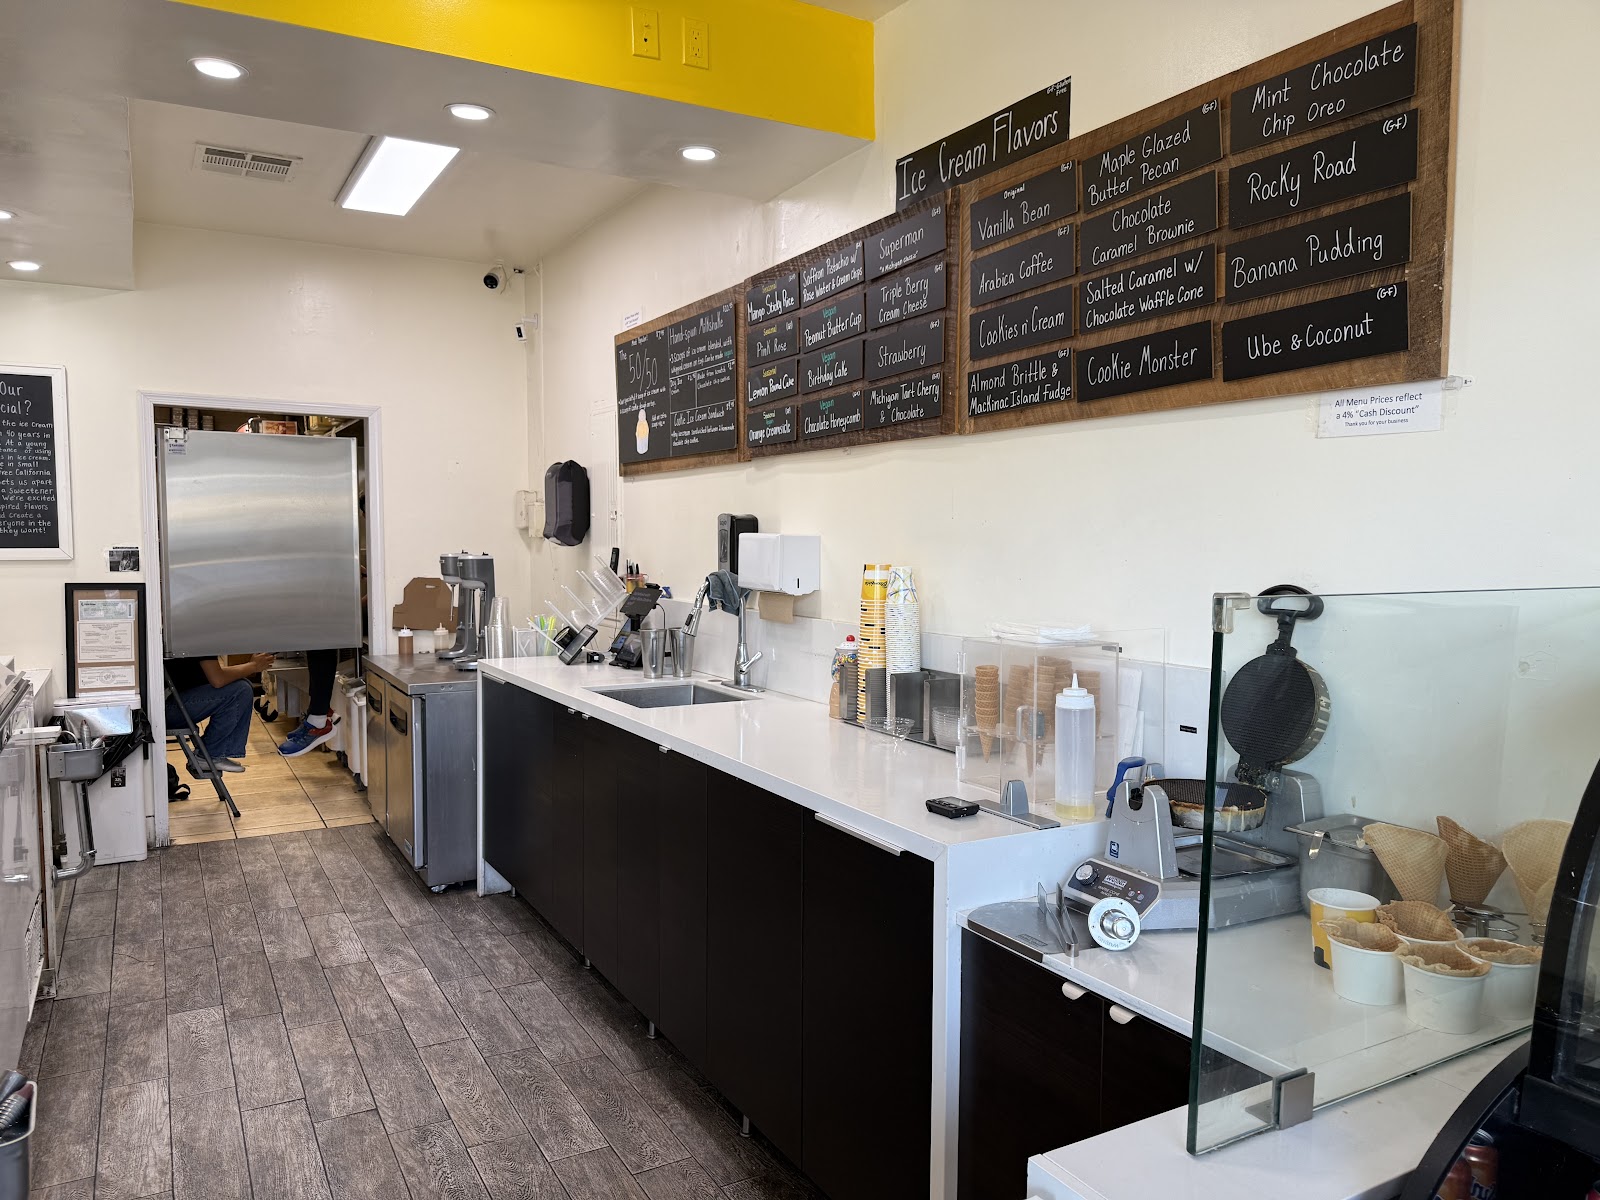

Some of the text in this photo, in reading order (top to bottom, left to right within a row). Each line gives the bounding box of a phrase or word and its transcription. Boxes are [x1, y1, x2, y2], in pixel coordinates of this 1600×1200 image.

[1252, 40, 1405, 113] Mint Chocolate
[1262, 98, 1346, 138] Chip Oreo
[898, 110, 1059, 201] Ice Cream Flavors
[1100, 120, 1191, 177] Maple Glazed
[1312, 141, 1357, 184] Road
[1003, 183, 1025, 199] Original
[1088, 157, 1179, 206] Butter Pecan
[978, 200, 1050, 241] Vanilla Bean
[1112, 195, 1171, 232] Chocolate
[879, 228, 924, 259] Superman
[1092, 219, 1194, 266] Caramel Brownie
[802, 267, 824, 287] Saffron
[826, 253, 849, 275] Pistachio
[1230, 226, 1384, 289] Banana Pudding
[978, 251, 1054, 295] Arabica Coffee
[1086, 251, 1204, 304] Salted Caramel w/
[880, 276, 929, 305] Triple Berry
[747, 301, 765, 322] Mango
[782, 289, 795, 308] Rice
[822, 305, 837, 320] Vegan
[878, 299, 928, 323] Cream Cheese
[1031, 305, 1065, 332] Cream
[1085, 285, 1204, 329] Chocolate Waffle Cone
[804, 312, 862, 347] Peanut Butter Cup
[1247, 311, 1374, 360] Ube & Coconut
[773, 337, 787, 353] Rose
[821, 351, 836, 367] Vegan
[877, 339, 926, 368] Strawberry
[1139, 340, 1198, 376] Monster
[629, 348, 658, 391] 50/50
[807, 364, 834, 388] Birthday
[969, 360, 1058, 393] Almond Brittle &
[0, 380, 23, 396] Our
[748, 381, 769, 402] Lemon
[769, 378, 782, 393] Pound
[869, 380, 940, 410] Michigan Tart Cherry
[1009, 385, 1040, 408] Island
[1042, 380, 1071, 401] Fudge
[1335, 392, 1423, 408] All Menu Prices reflect
[804, 408, 861, 434] Chocolate Honeycomb
[819, 399, 835, 415] Vegan
[880, 403, 924, 423] & Chocolate
[1342, 410, 1354, 419] 4%
[18, 431, 41, 440] years
[25, 441, 47, 450] young
[748, 429, 766, 444] Orange
[34, 448, 52, 456] using
[15, 468, 52, 476] California
[24, 502, 49, 511] flavors
[27, 494, 56, 502] excited
[20, 526, 46, 534] want!
[28, 519, 52, 527] in the
